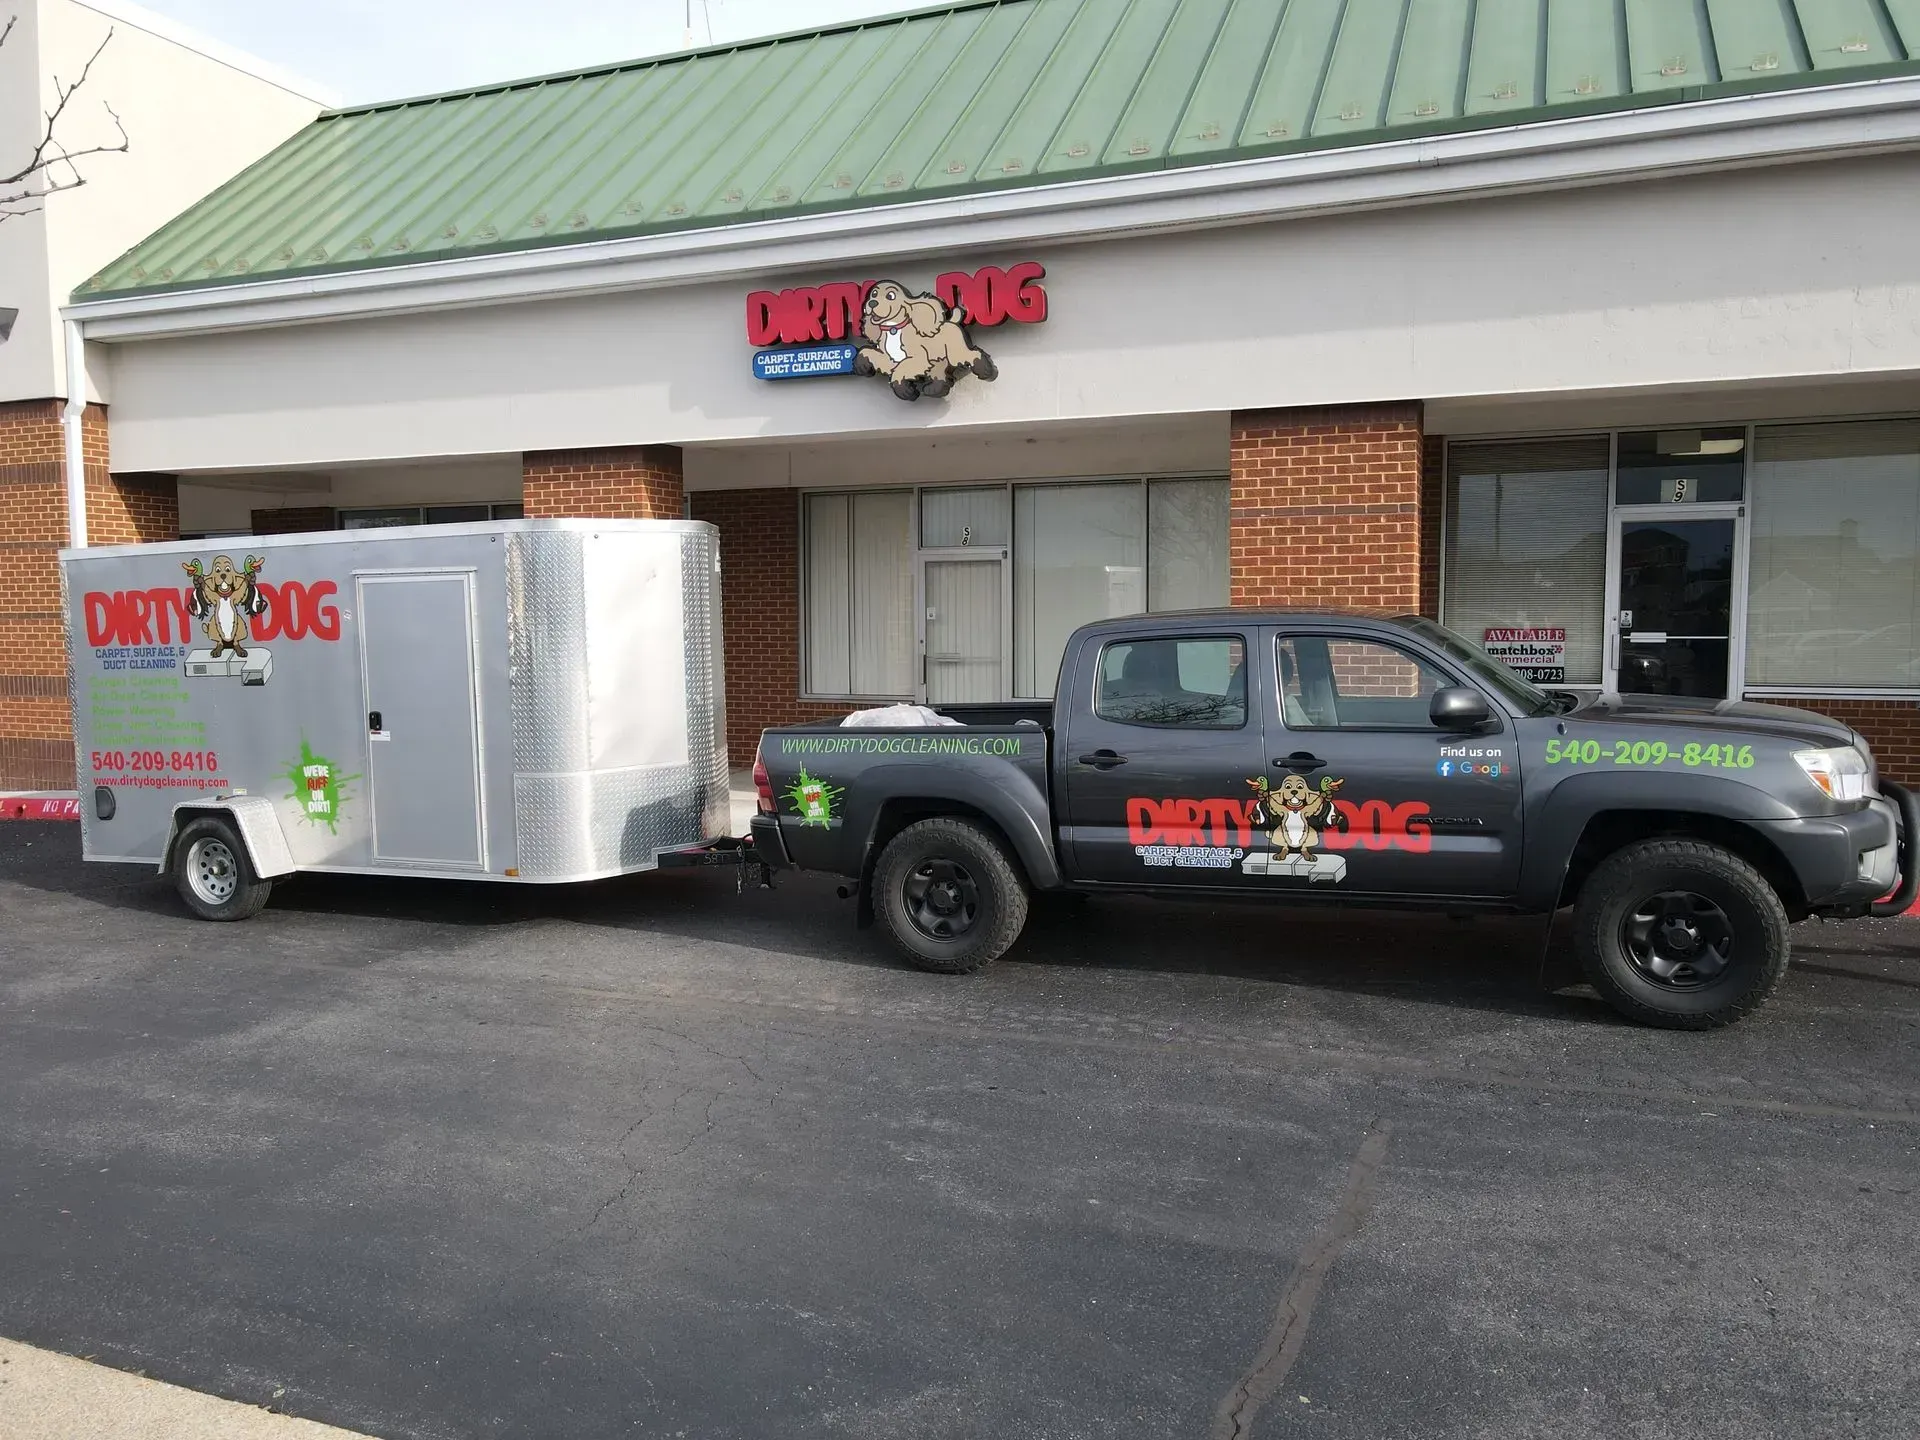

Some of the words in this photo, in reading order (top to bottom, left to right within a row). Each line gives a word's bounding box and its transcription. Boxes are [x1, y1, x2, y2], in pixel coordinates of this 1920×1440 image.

[746, 280, 877, 347] DIRTY
[936, 261, 1048, 327] DOG
[844, 349, 852, 359] &
[764, 364, 789, 375] DUCT
[792, 360, 842, 373] CLEANING
[83, 587, 192, 647] DIRTY
[250, 580, 341, 642] DOG
[1487, 629, 1564, 641] AVAILABLE
[178, 646, 185, 657] &
[1487, 644, 1555, 656] matchbox
[103, 660, 126, 670] DUCT
[129, 659, 176, 670] CLEANING
[1496, 655, 1555, 664] mmercial
[782, 738, 1021, 755] WWW.DIRTYDOGCLEANING.COM
[1440, 746, 1466, 757] Find
[1469, 749, 1483, 757] us
[1486, 749, 1502, 757] on
[1545, 739, 1755, 769] 540-209-8416
[91, 751, 218, 772] 540-209-8416
[1460, 761, 1511, 777] Google
[93, 775, 229, 790] www.dirtydogcleaning.com
[42, 799, 59, 813] NO
[1126, 798, 1256, 850] DIRTY
[1322, 801, 1433, 854] DOG
[1144, 856, 1174, 867] DUCT
[1175, 857, 1232, 868] CLEANING
